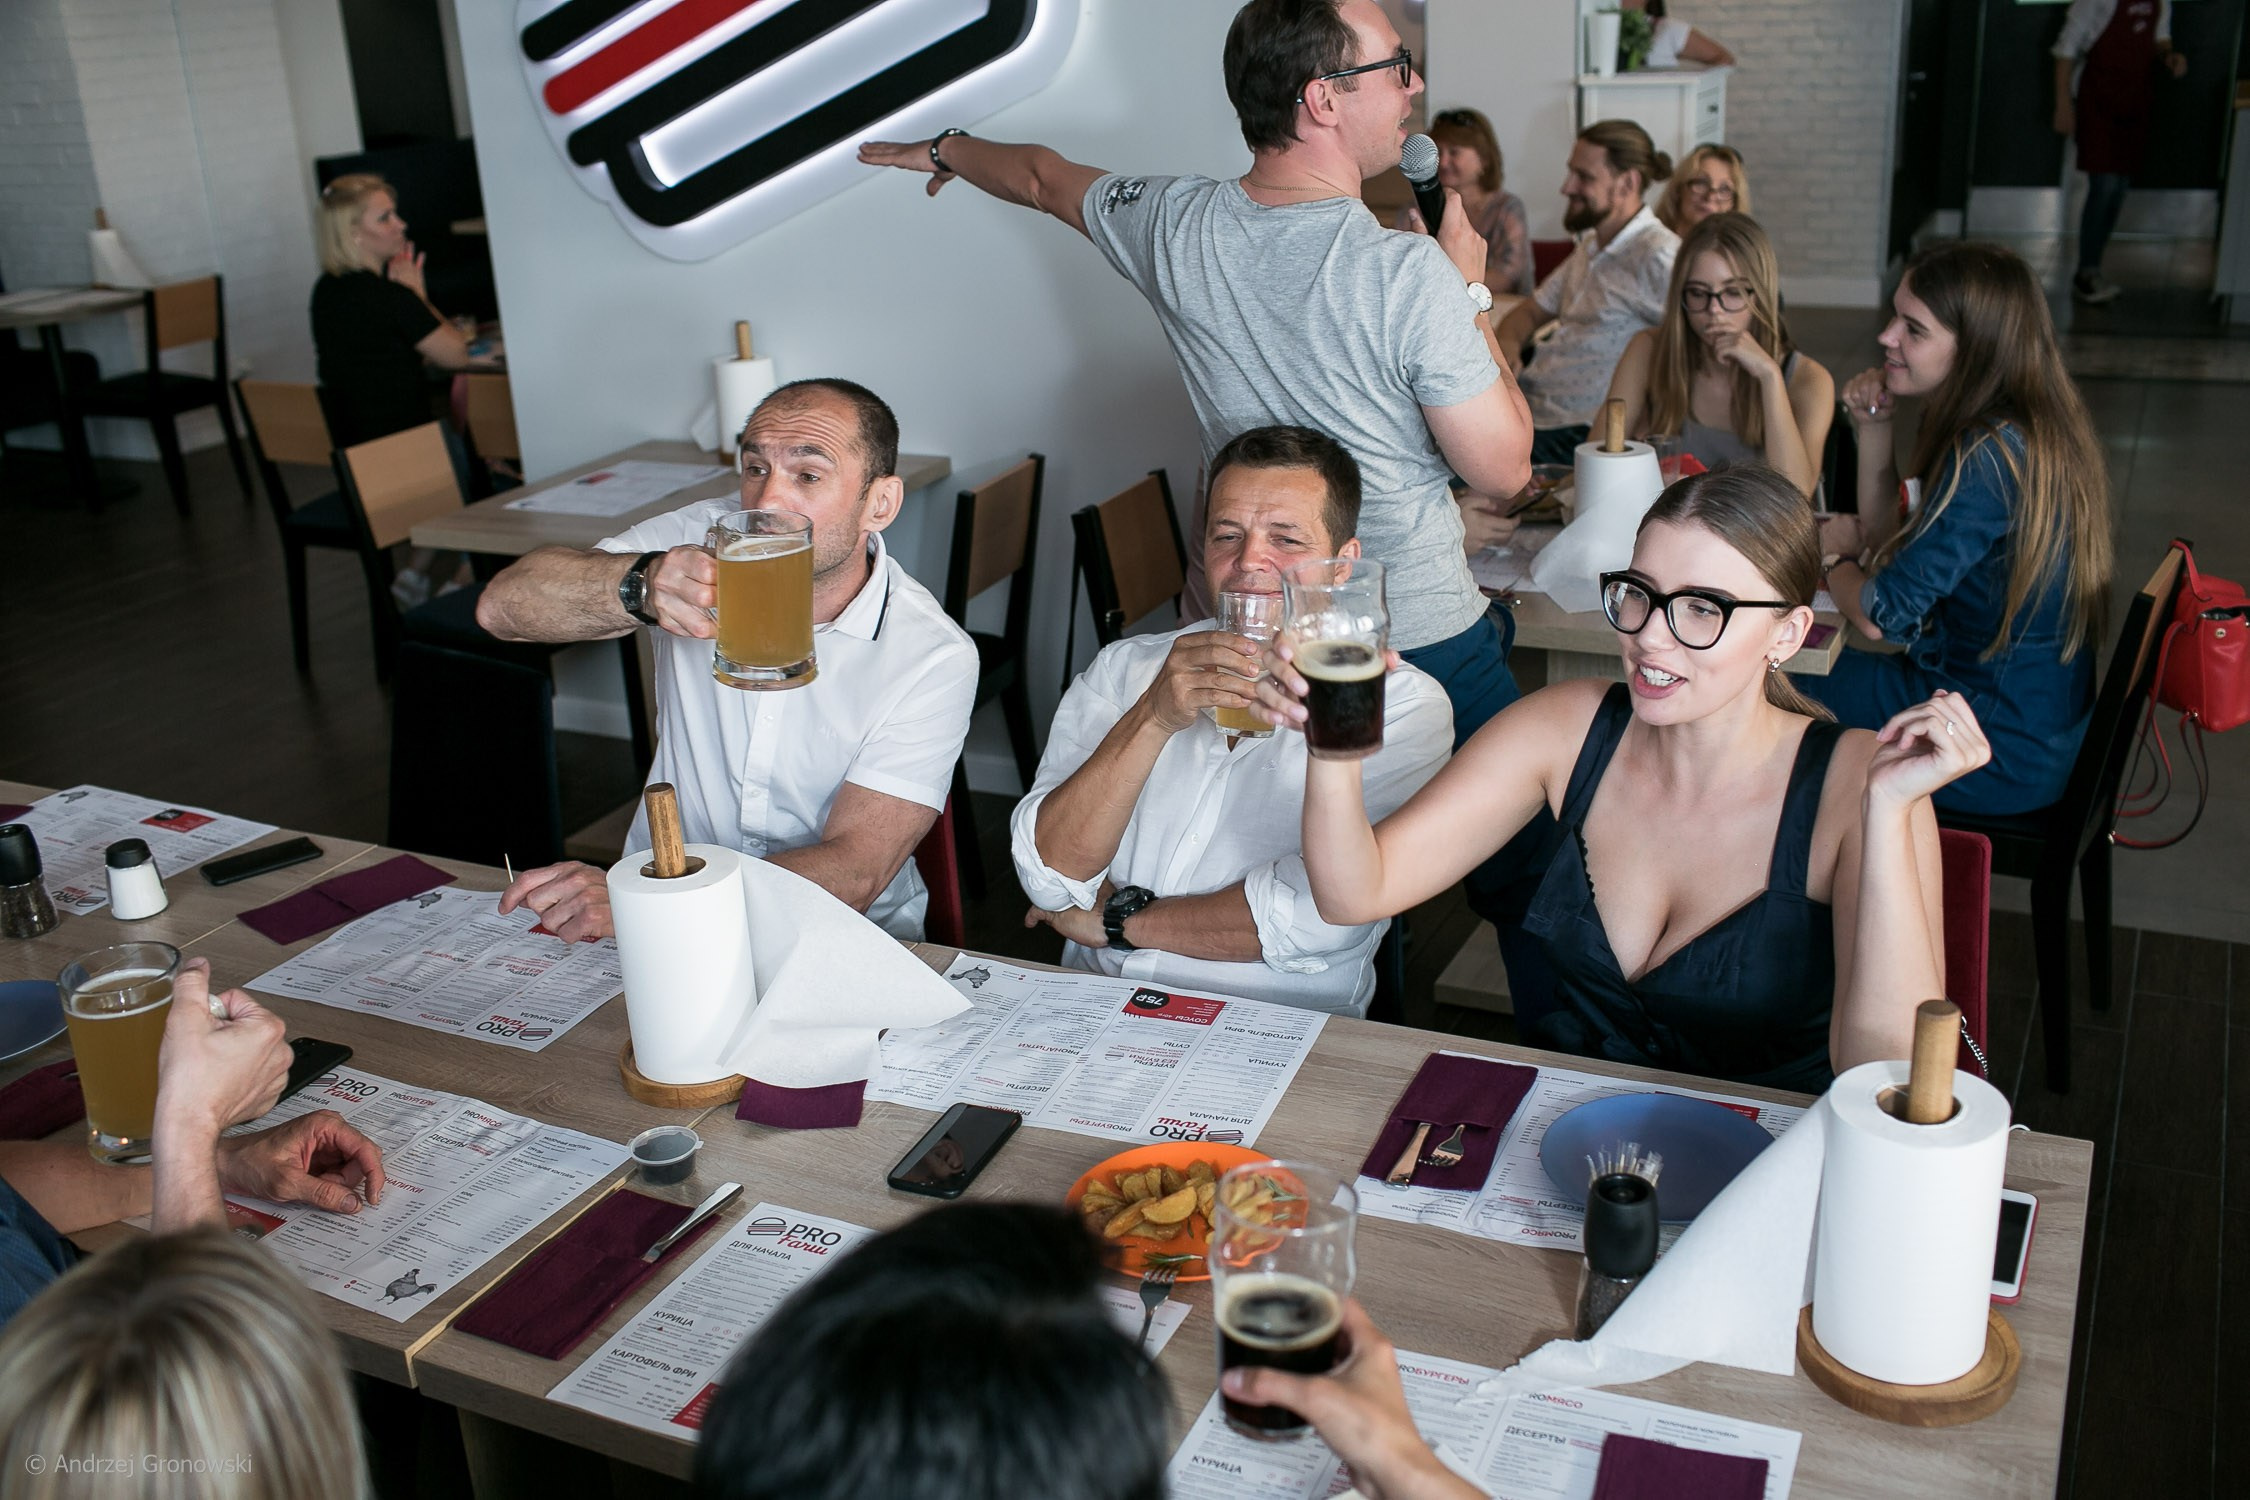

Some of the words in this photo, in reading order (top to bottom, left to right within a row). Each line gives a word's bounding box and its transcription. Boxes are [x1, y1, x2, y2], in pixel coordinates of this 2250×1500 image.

[520, 1012, 551, 1021] НАЧАЛА
[1174, 1014, 1208, 1023] СОУСЫ
[476, 1021, 522, 1037] PRO
[1248, 1030, 1303, 1041] КАРТОФЕЛЬ
[1018, 1043, 1080, 1055] PROНАПИТКИ
[1129, 1054, 1160, 1062] БУЛКИ
[1134, 1059, 1175, 1069] БУРГЕРЫ
[1249, 1058, 1287, 1068] КУРИЦА
[332, 1078, 379, 1097] PRO
[1006, 1083, 1050, 1092] ДЕСЕРТЫ
[299, 1094, 330, 1105] НАЧАЛА
[458, 1110, 503, 1128] PROМЯСО
[1190, 1112, 1229, 1121] НАЧАЛА
[1069, 1118, 1132, 1132] PROБУРГЕРЫ
[428, 1134, 469, 1148] ДЕСЕРТЫ
[1150, 1125, 1203, 1143] PRO
[786, 1224, 842, 1246] PRO
[1522, 1229, 1577, 1240] PROМЯСО
[729, 1241, 753, 1250] ДЛЯ
[752, 1246, 792, 1261] НАЧАЛА
[653, 1311, 694, 1327] КУРИЦА
[611, 1349, 671, 1371] КАРТОФЕЛЬ
[673, 1367, 697, 1378] ФРИ
[1505, 1426, 1566, 1444] ДЕСЕРТЫ
[1191, 1454, 1242, 1474] КУРИЦА
